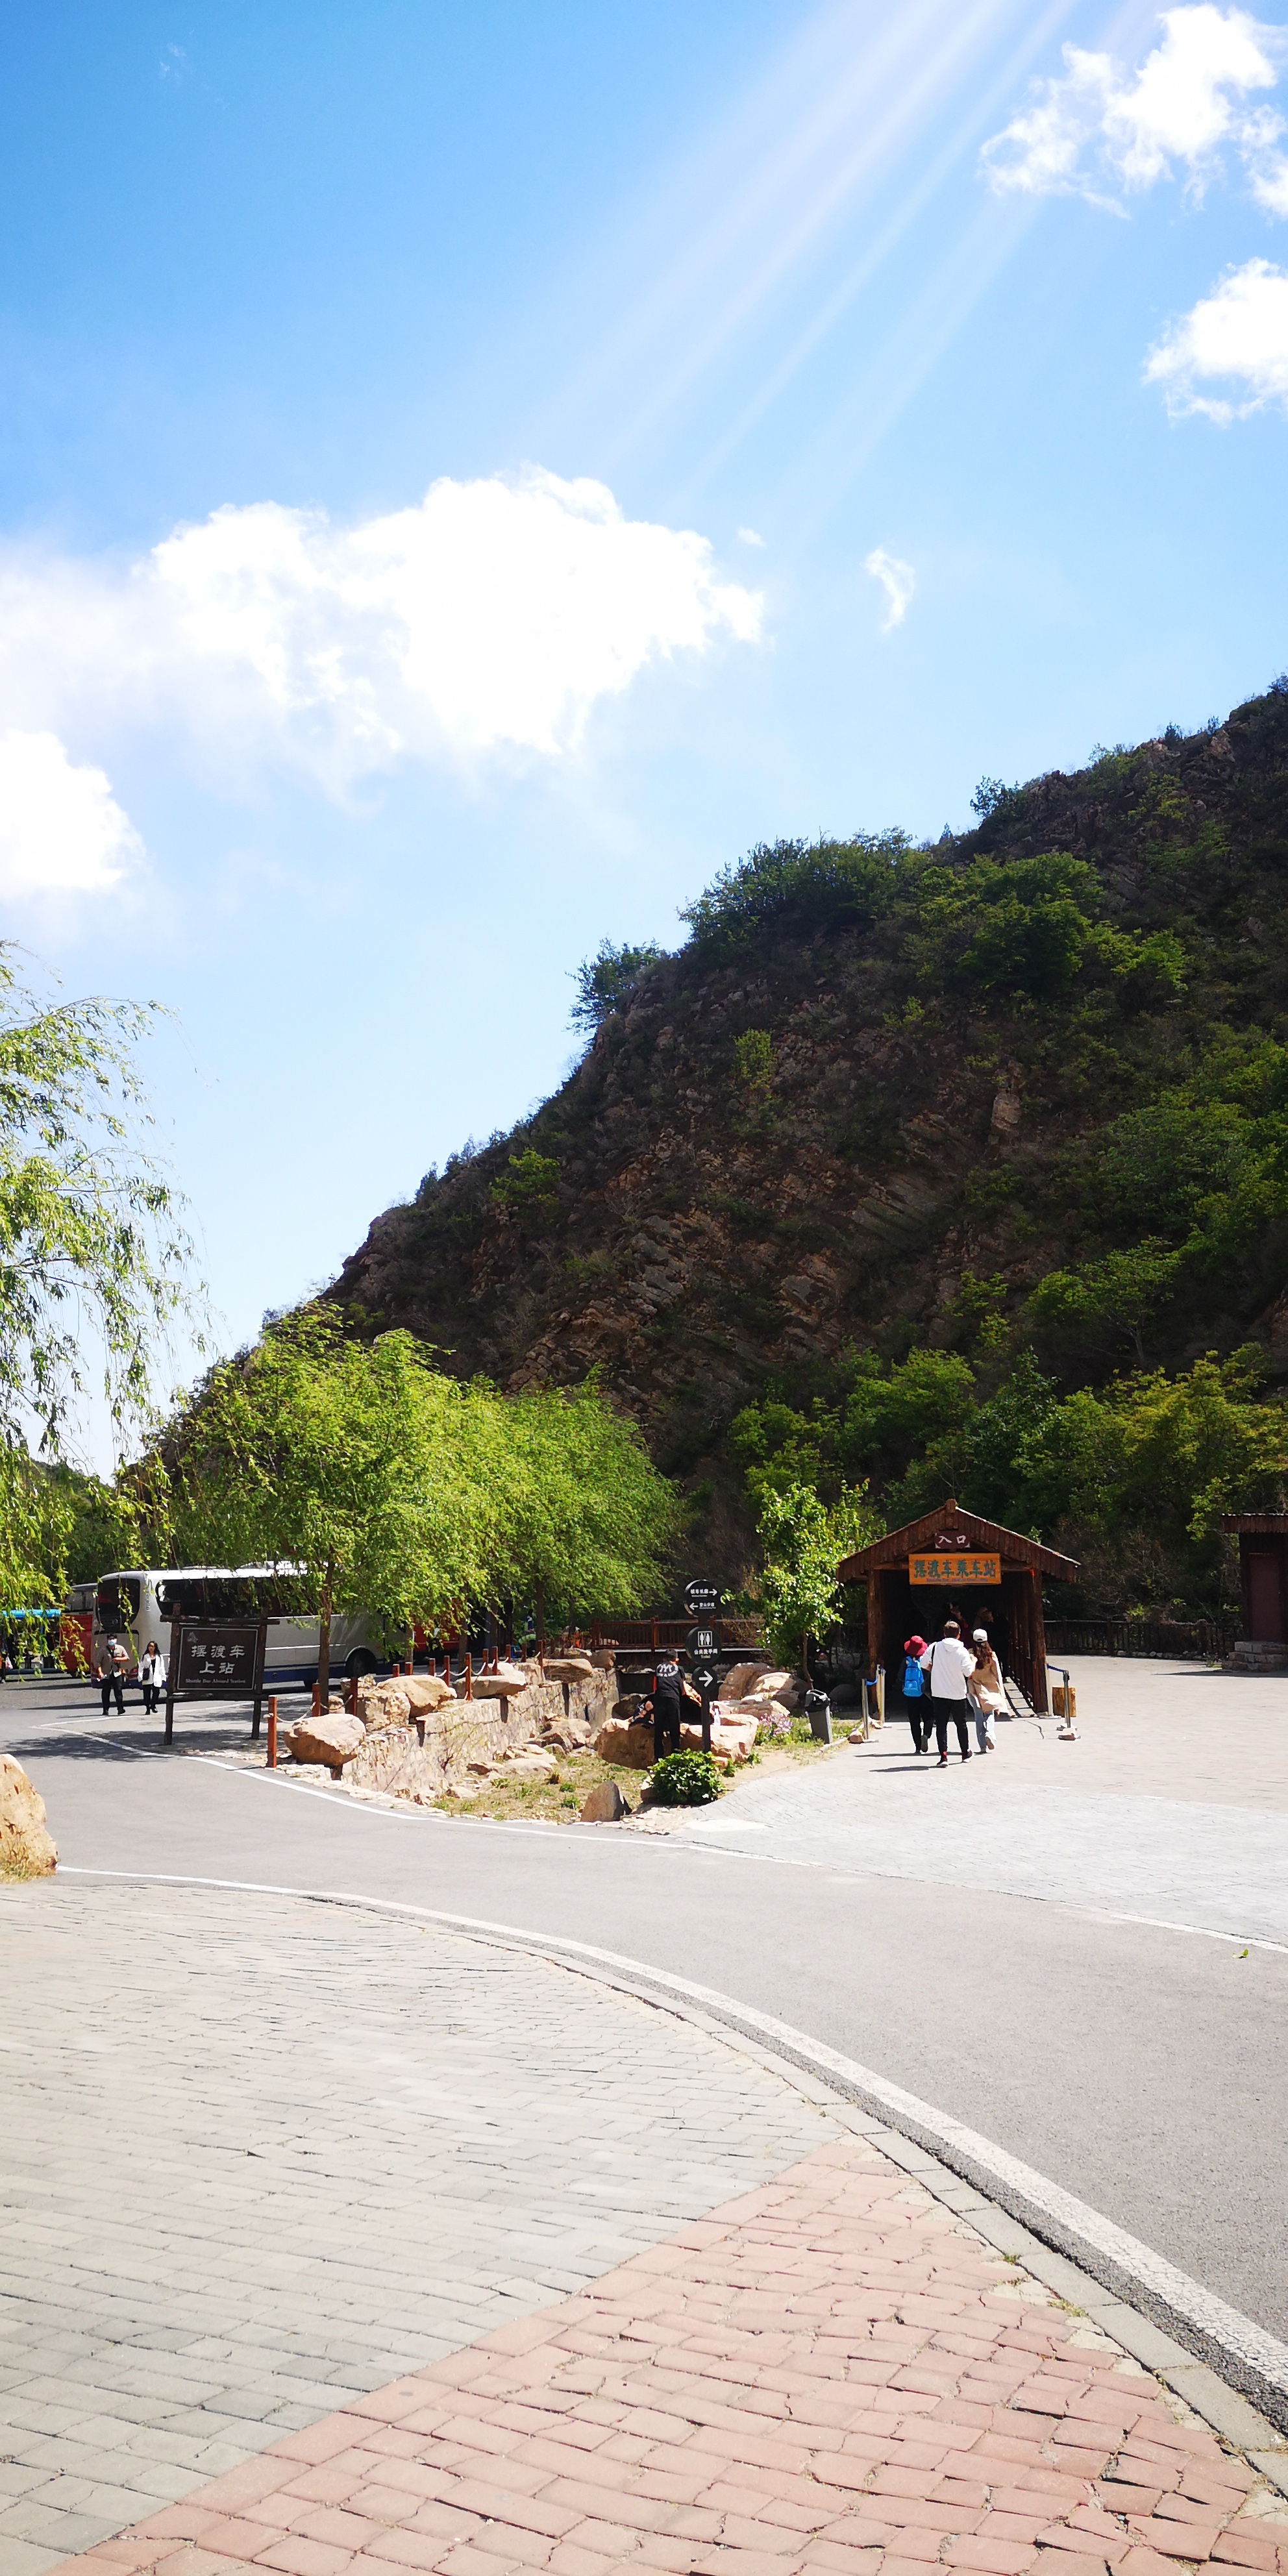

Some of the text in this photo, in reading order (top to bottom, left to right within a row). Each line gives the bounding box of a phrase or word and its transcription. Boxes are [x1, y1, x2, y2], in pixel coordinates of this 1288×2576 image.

[938, 1535, 966, 1544] 入口
[191, 1644, 245, 1659] 摆渡车
[199, 1661, 235, 1674] 上站
